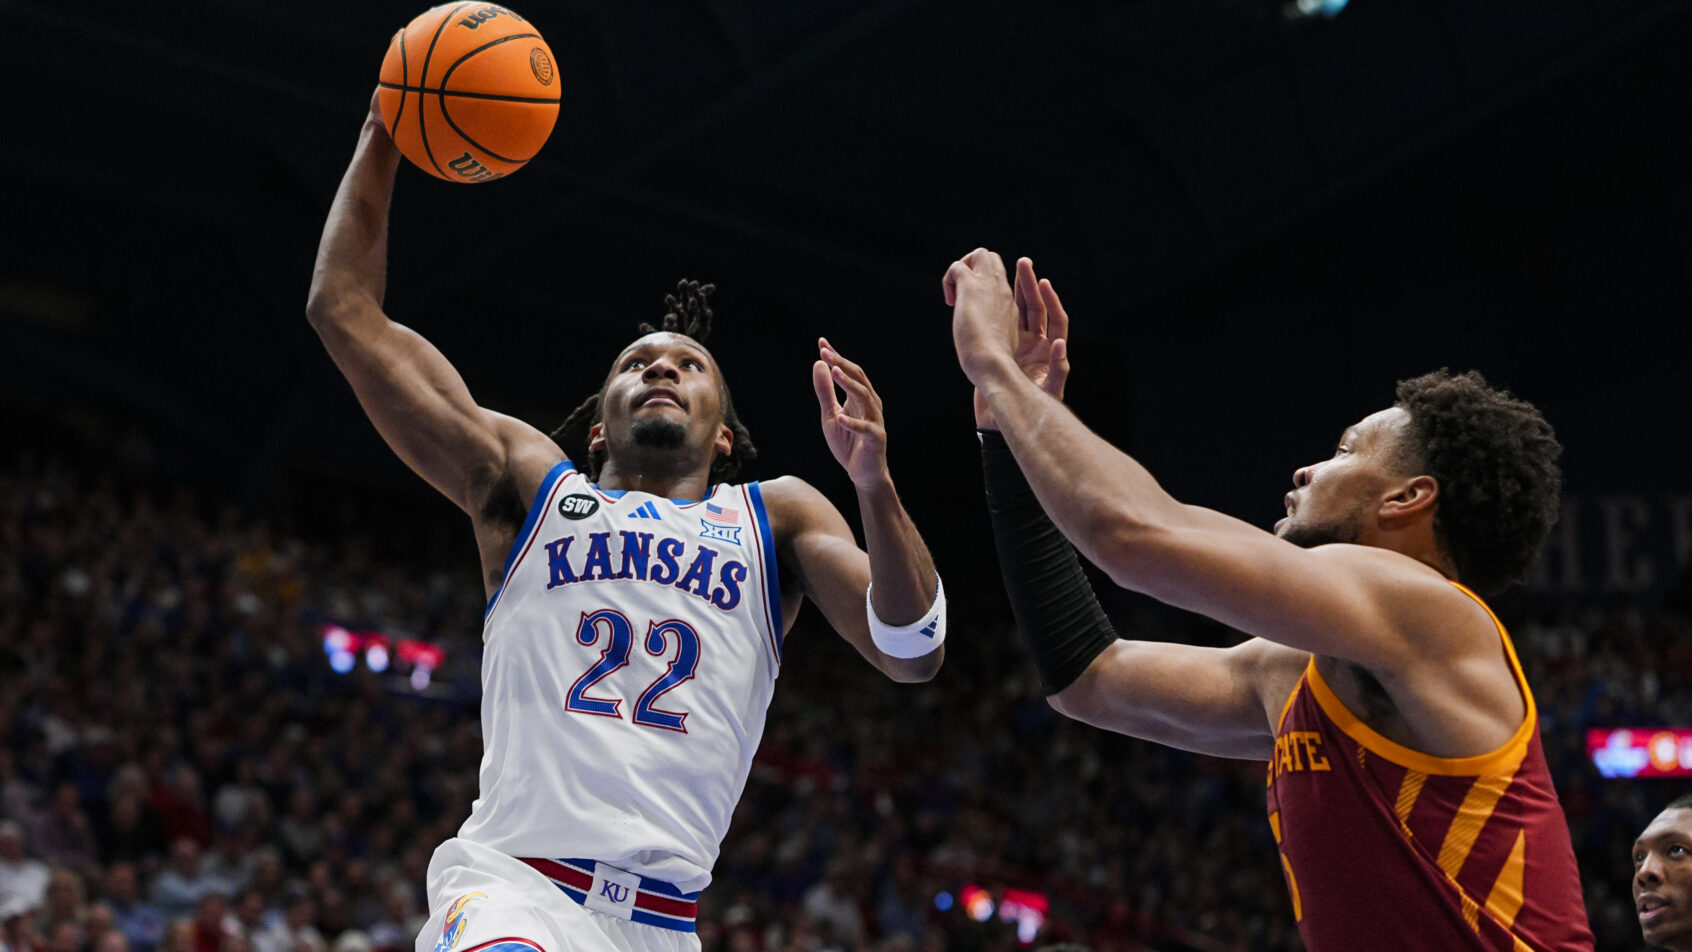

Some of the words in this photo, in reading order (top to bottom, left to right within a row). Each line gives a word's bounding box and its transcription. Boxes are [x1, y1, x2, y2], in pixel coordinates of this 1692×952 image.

[562, 496, 595, 514] SW
[545, 530, 747, 610] KANSAS
[565, 608, 701, 734] 22
[600, 879, 630, 903] KU
